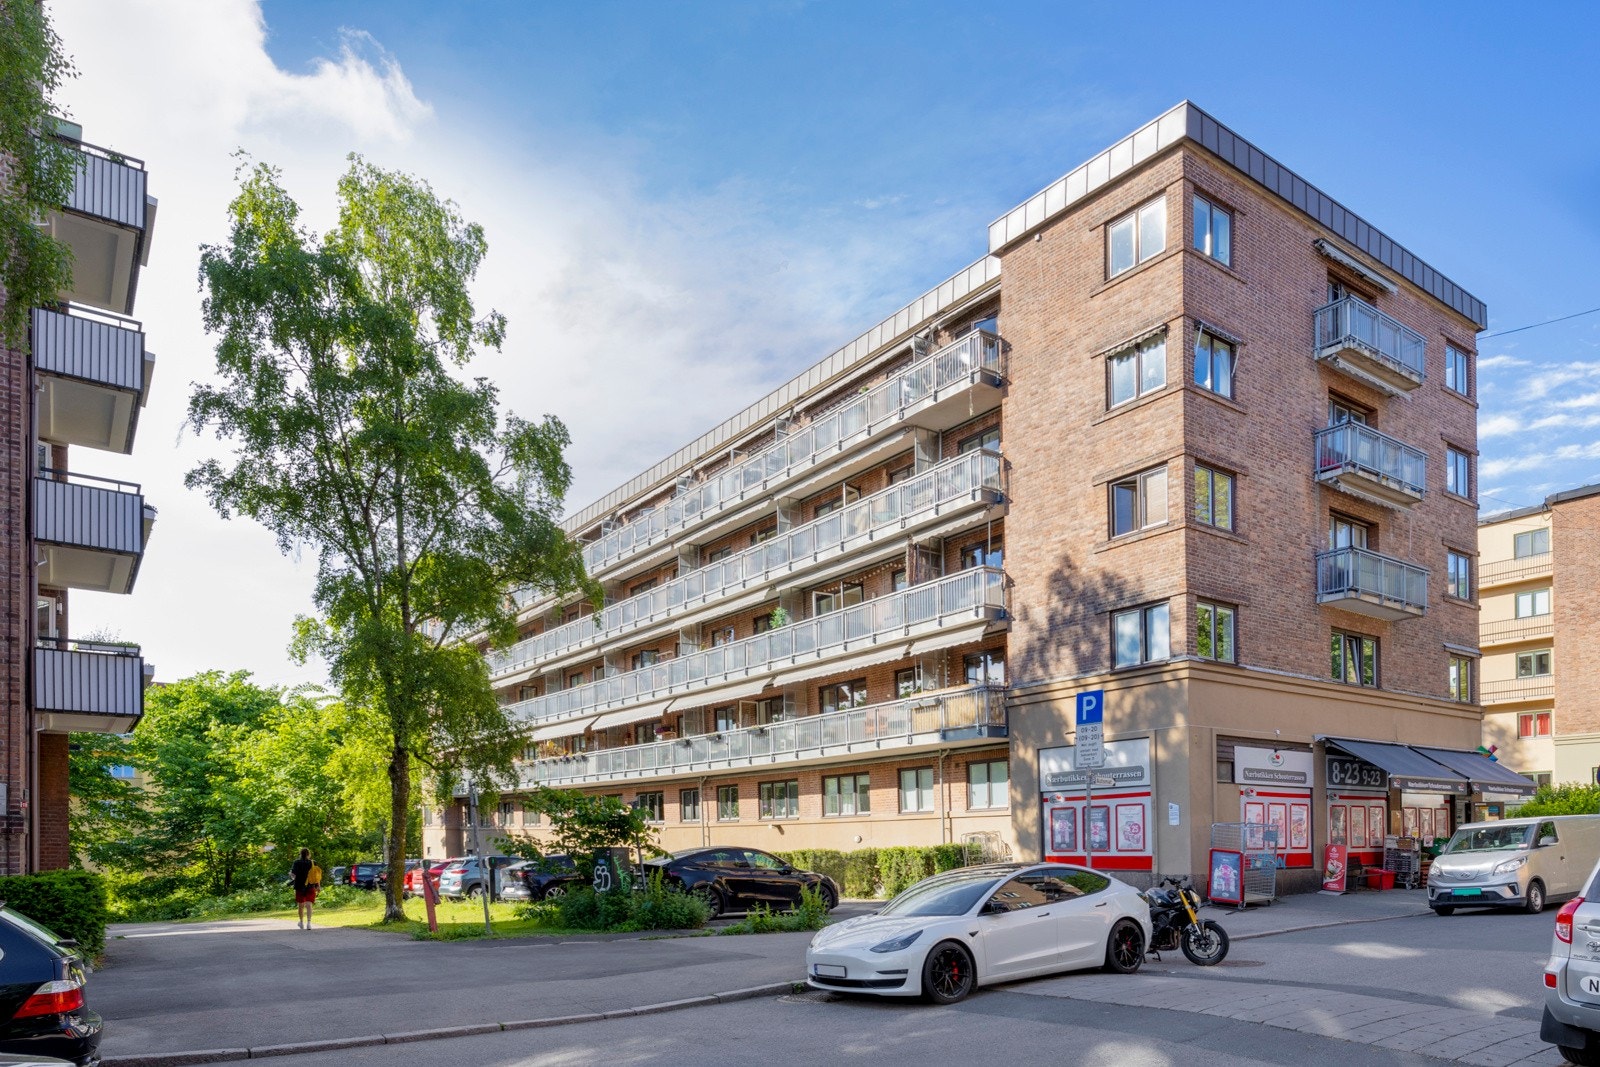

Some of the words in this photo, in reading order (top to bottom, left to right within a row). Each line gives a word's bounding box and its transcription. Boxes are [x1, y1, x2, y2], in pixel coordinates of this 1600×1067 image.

[1082, 695, 1097, 720] P
[1046, 774, 1087, 783] Nærbutikke
[1332, 762, 1360, 784] 8-23
[1362, 770, 1381, 786] 9-23
[1589, 978, 1600, 993] N
